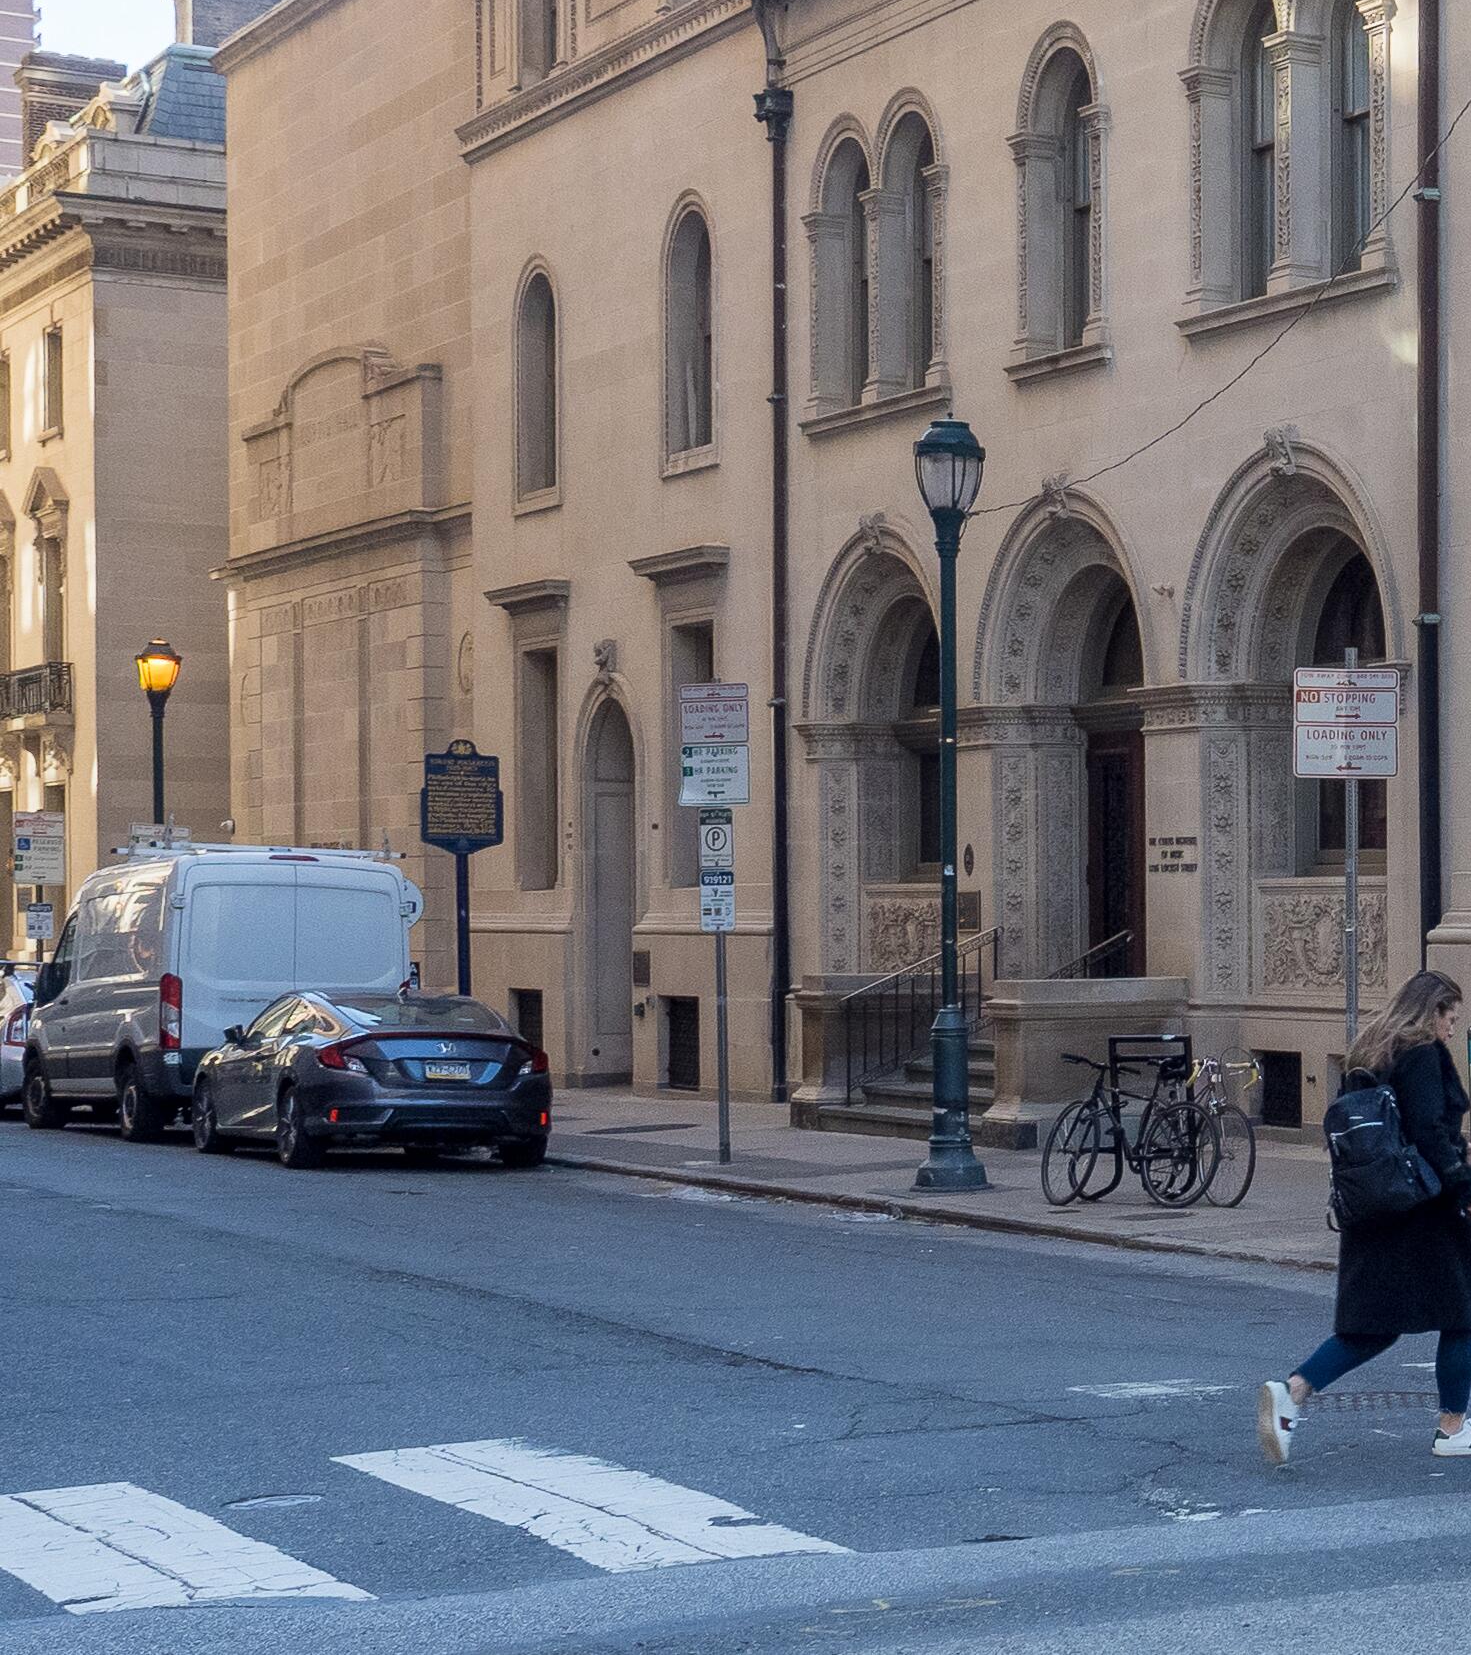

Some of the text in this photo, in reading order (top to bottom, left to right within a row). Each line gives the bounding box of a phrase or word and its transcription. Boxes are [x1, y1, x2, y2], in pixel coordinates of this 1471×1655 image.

[1300, 691, 1376, 704] NO STOPPING
[1306, 730, 1388, 741] LOADING ONLY
[706, 766, 738, 774] PARKING
